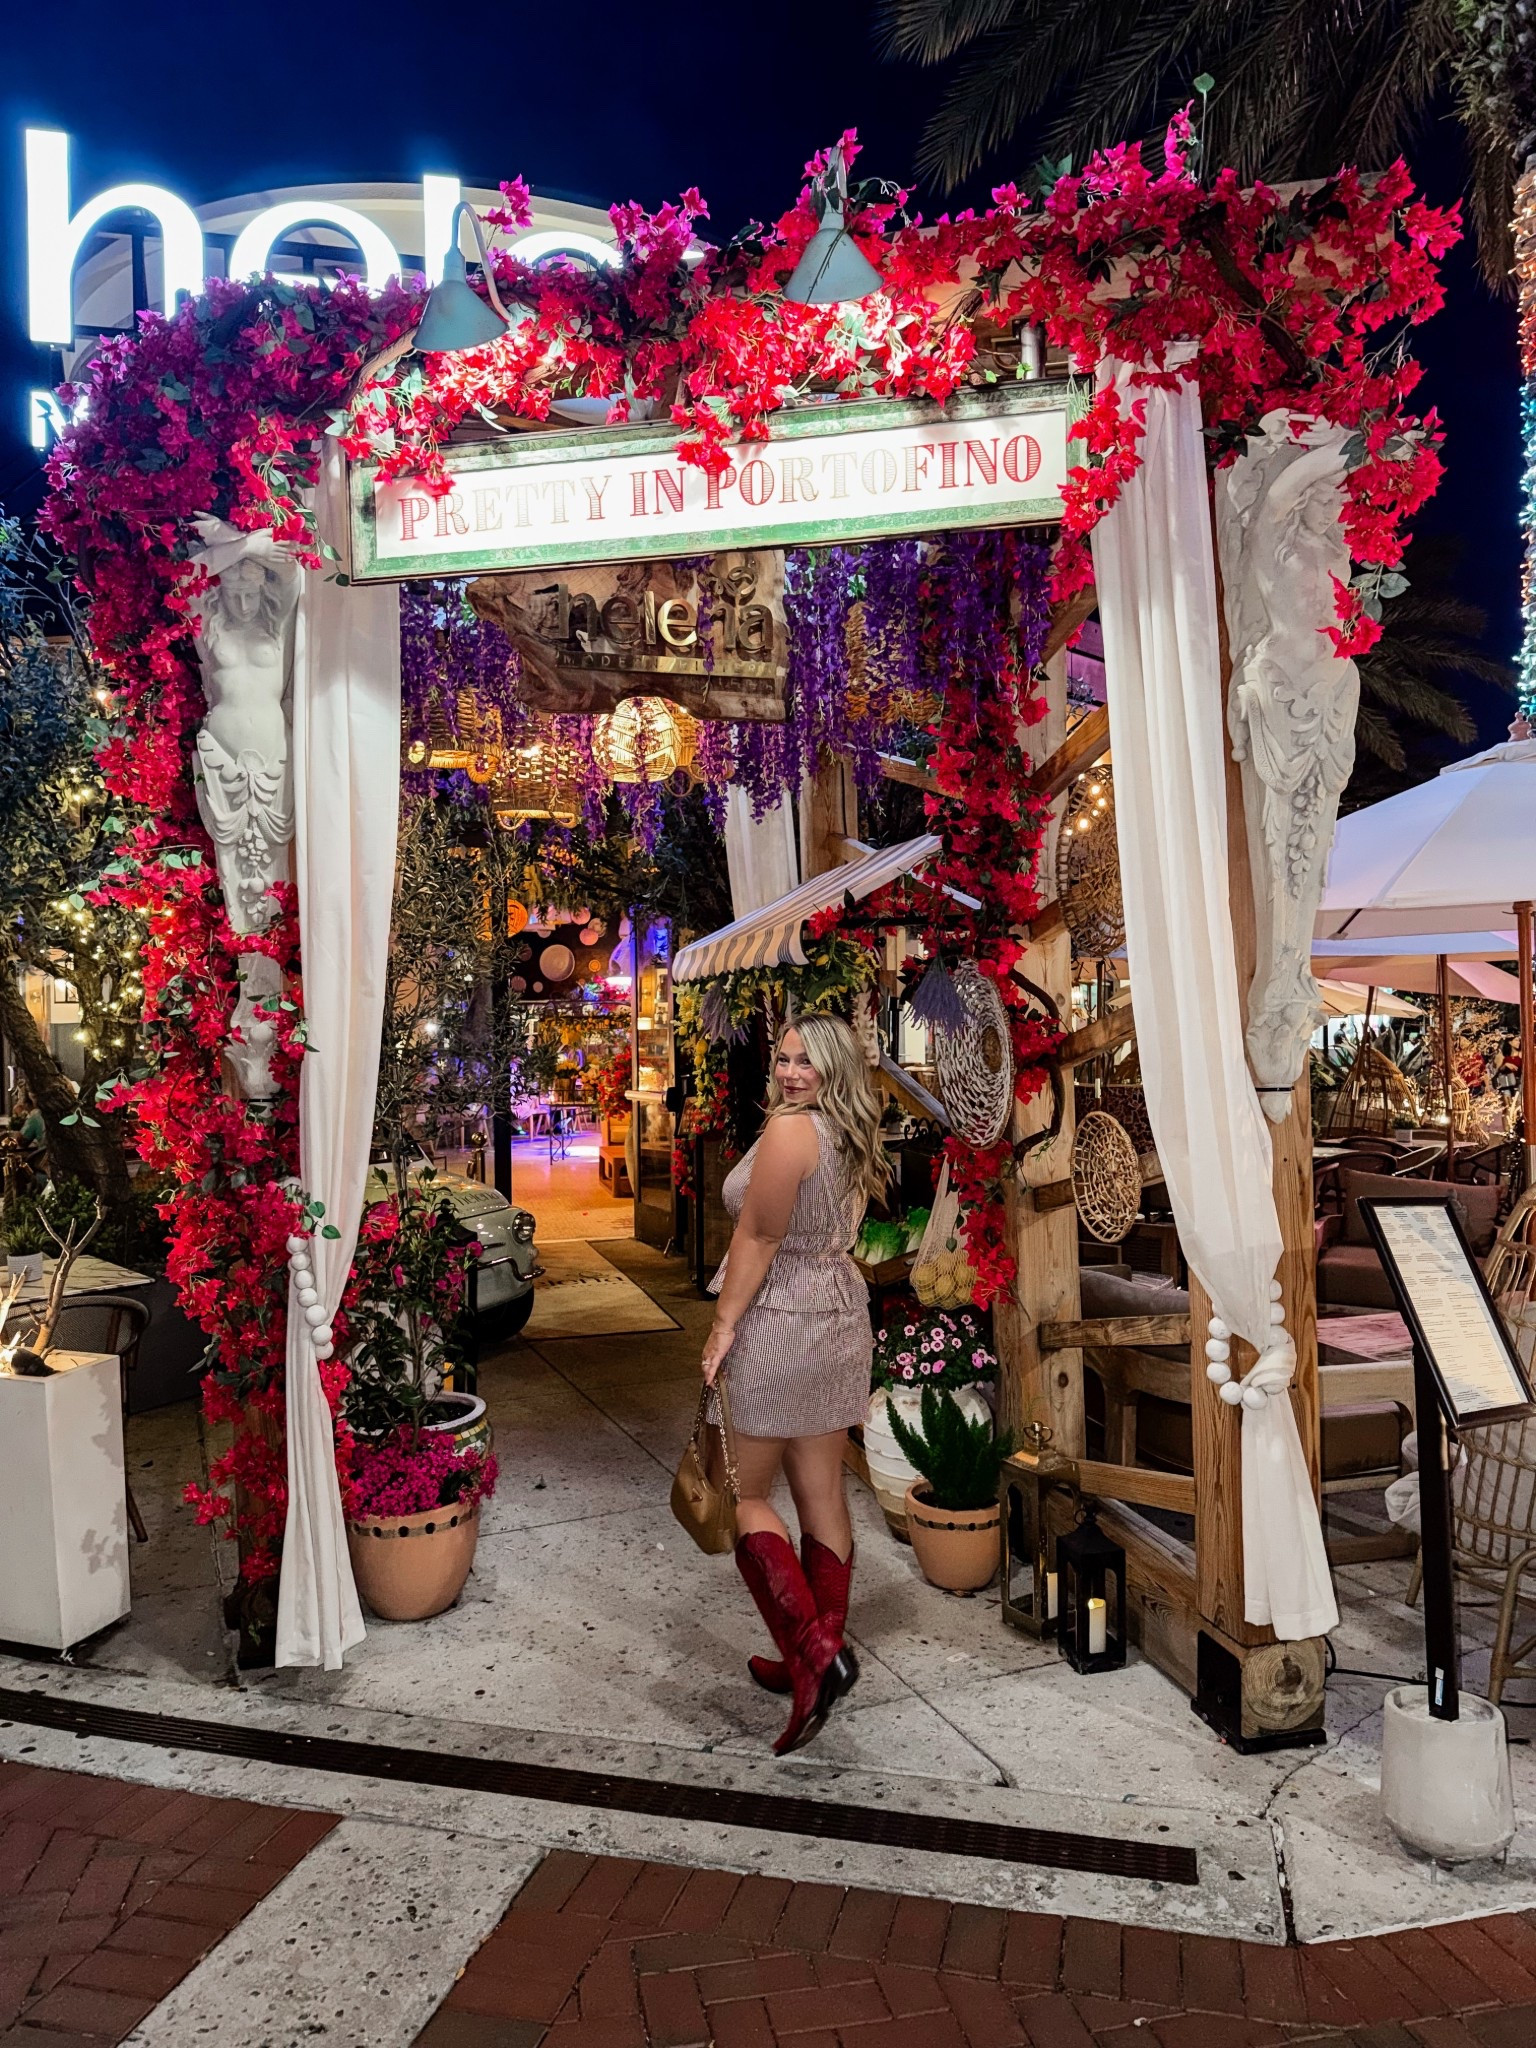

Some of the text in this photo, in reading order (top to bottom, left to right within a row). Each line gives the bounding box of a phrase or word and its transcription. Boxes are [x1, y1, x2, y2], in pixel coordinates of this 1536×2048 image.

[400, 434, 1041, 541] PRETTY IN PORTOFINO
[558, 583, 773, 651] helena
